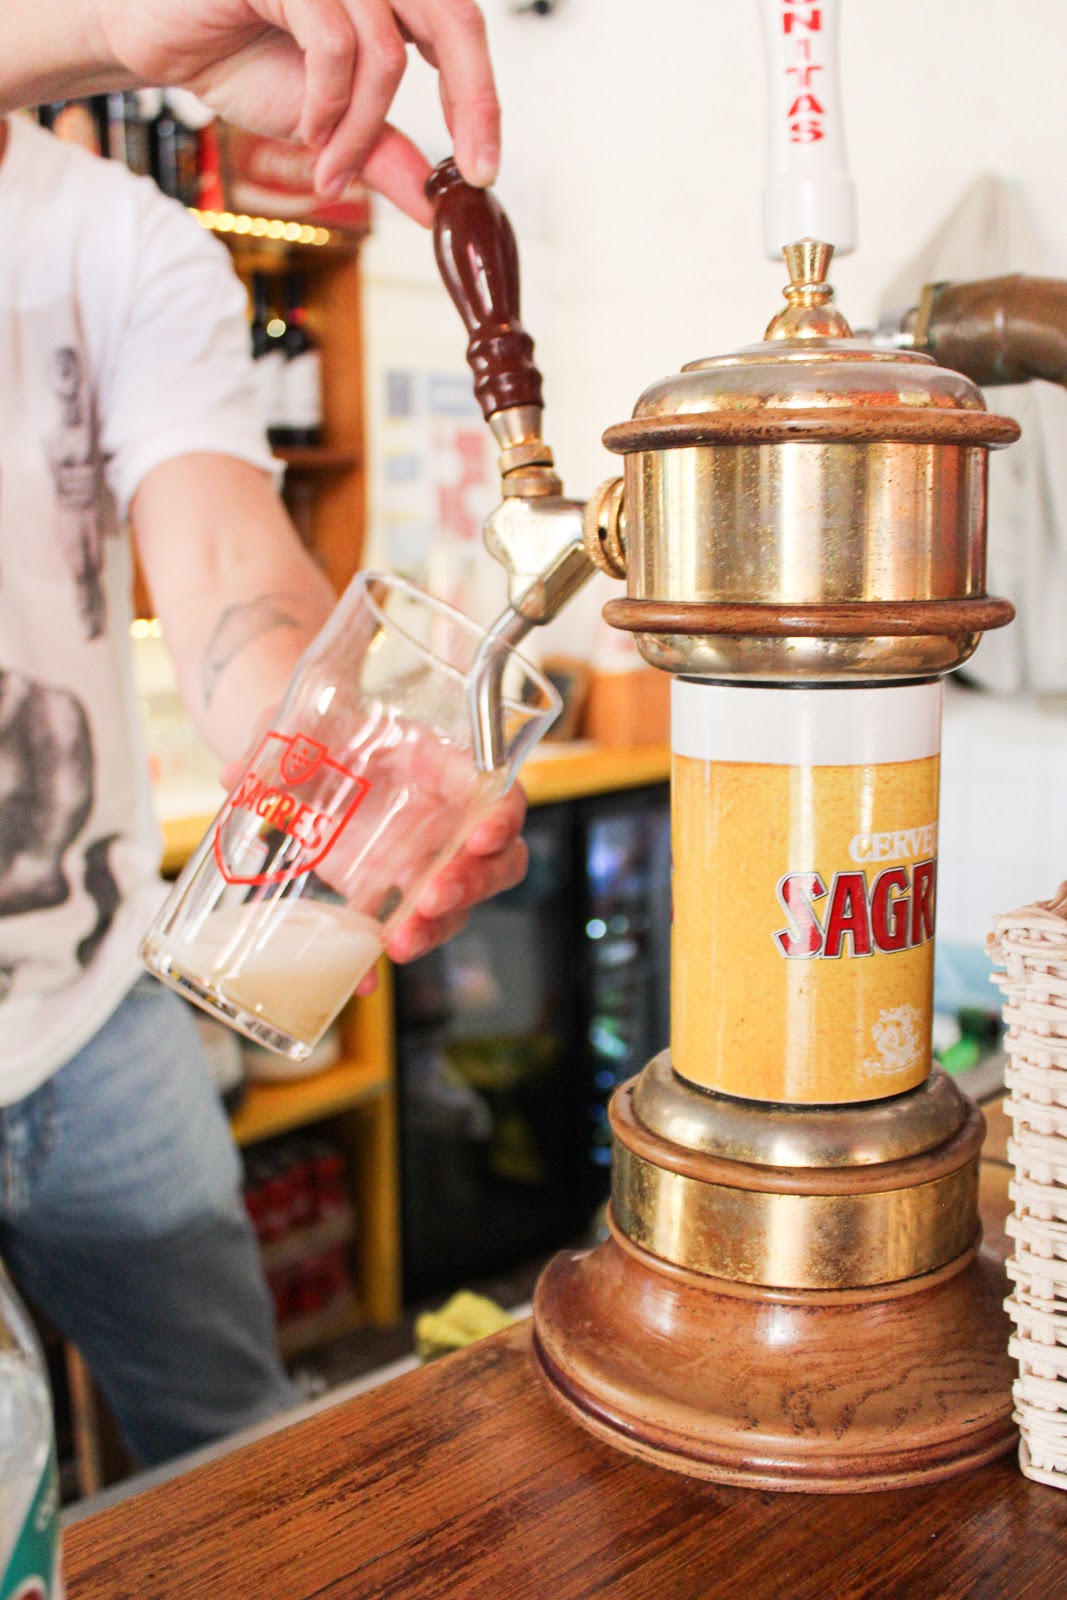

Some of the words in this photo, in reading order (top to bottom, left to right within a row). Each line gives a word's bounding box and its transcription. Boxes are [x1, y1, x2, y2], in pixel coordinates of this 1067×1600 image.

[783, 0, 825, 143] NITAS
[232, 773, 334, 850] SAGRES
[772, 856, 937, 960] SAGR
